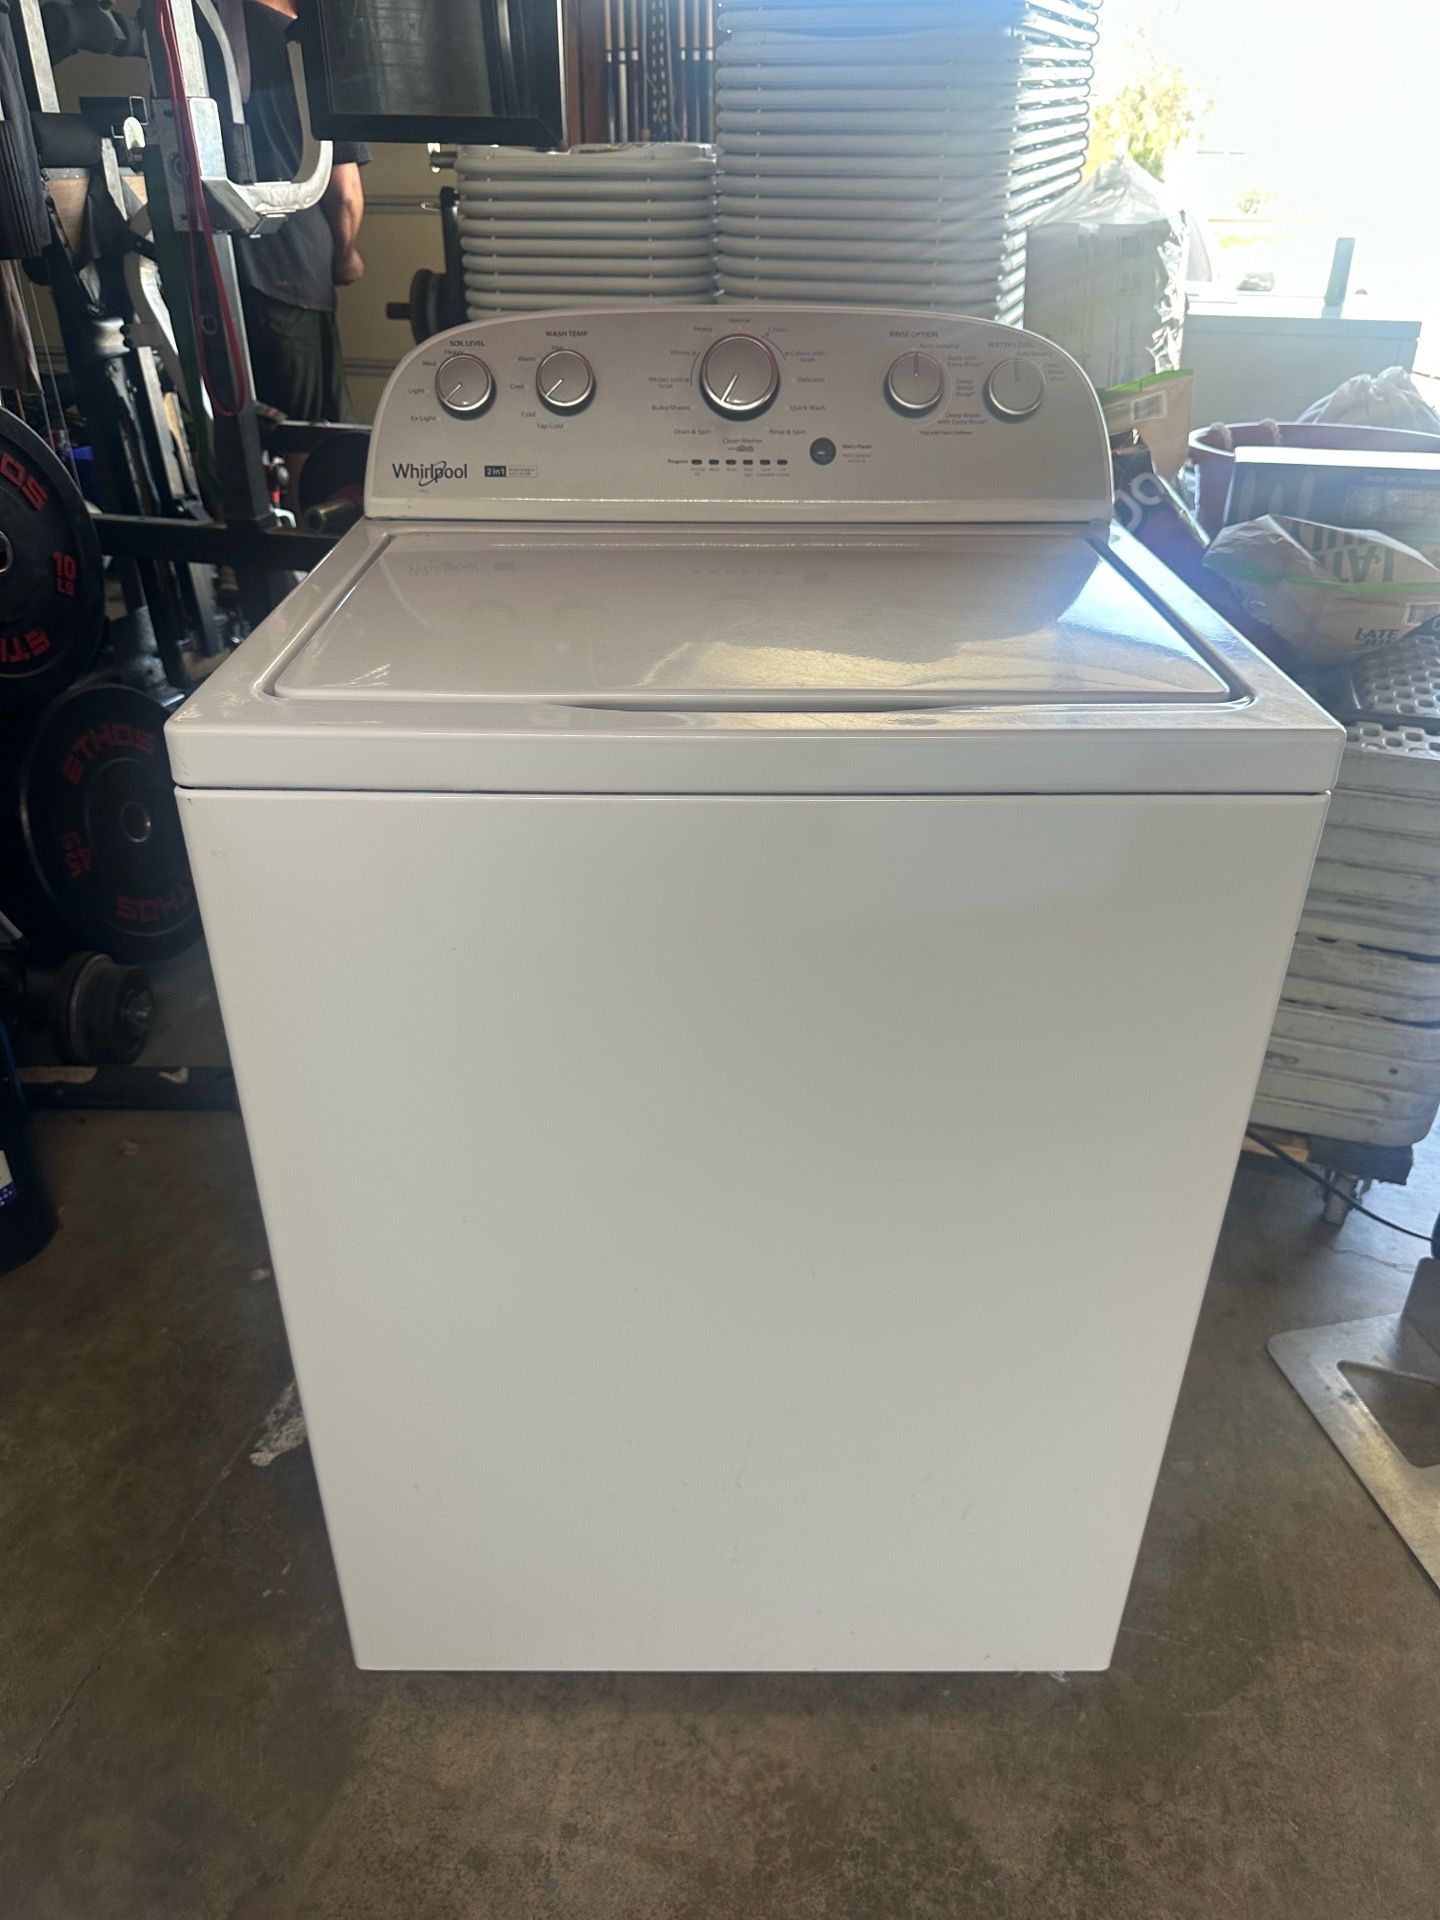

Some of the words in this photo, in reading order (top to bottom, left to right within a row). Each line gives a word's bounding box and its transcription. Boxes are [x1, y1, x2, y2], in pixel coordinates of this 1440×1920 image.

[408, 387, 425, 395] Light
[392, 461, 468, 486] Whirlpool
[1354, 627, 1400, 640] LATE
